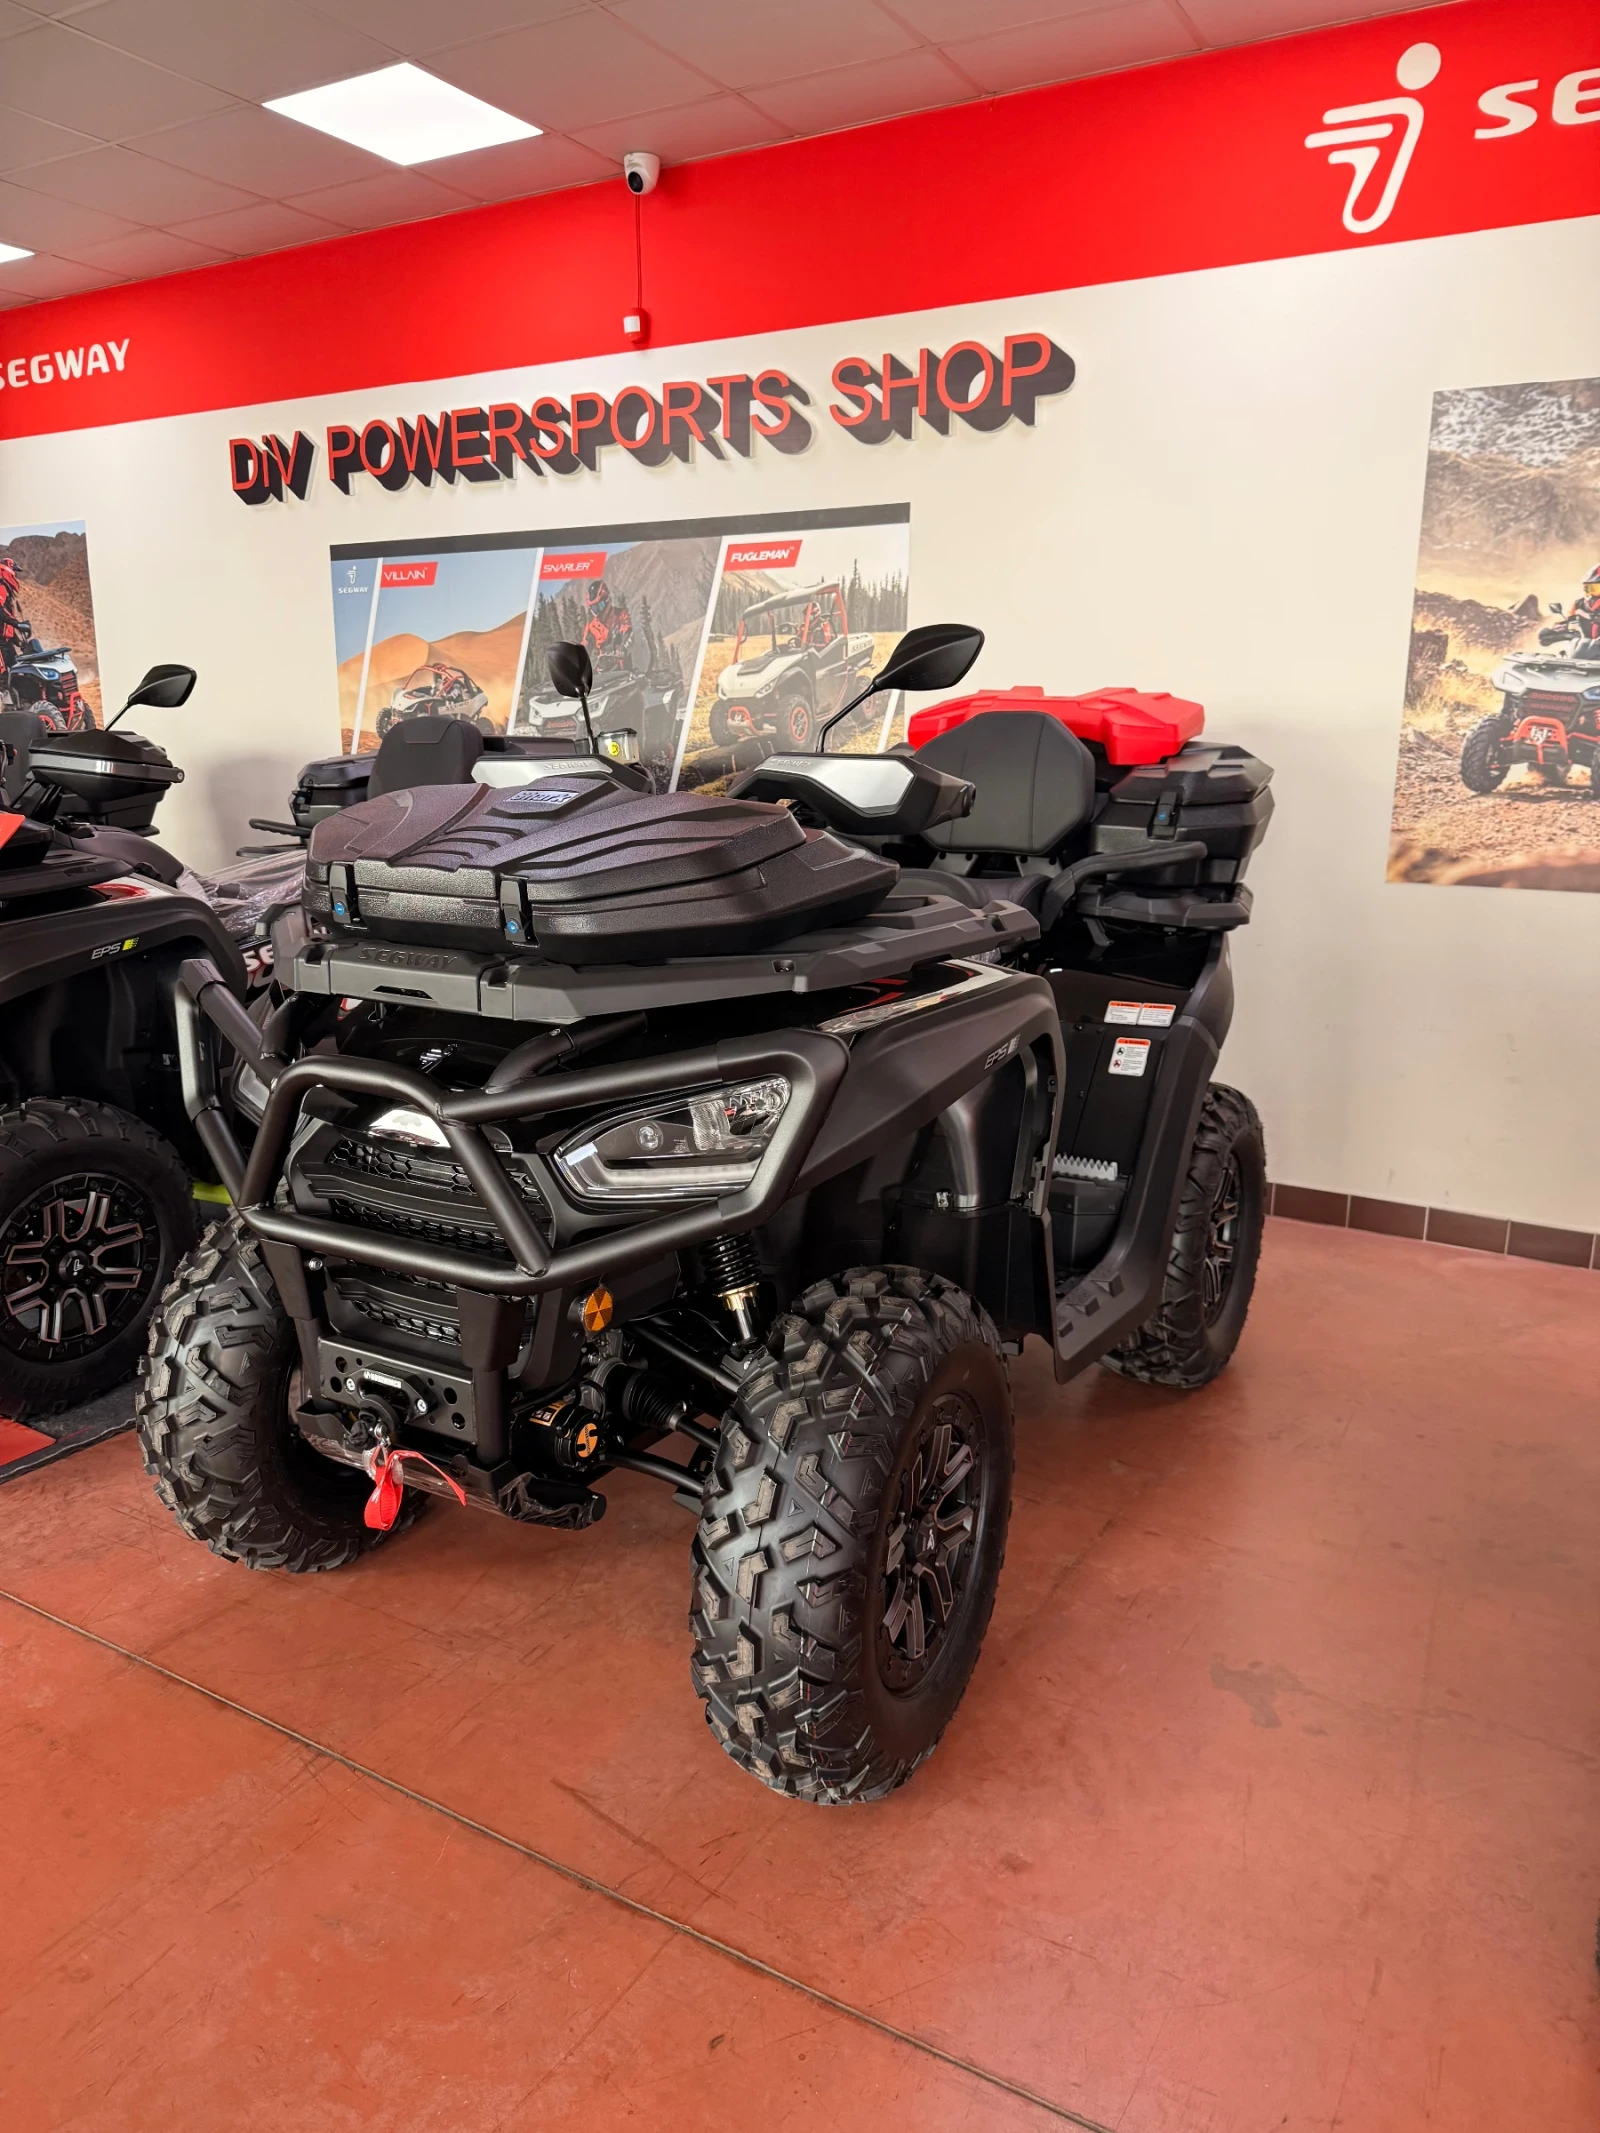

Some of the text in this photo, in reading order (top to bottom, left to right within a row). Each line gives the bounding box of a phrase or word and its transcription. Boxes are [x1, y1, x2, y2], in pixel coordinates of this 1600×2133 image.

[0, 338, 130, 391] EGWAY
[326, 369, 791, 480] POWERSPORTS
[829, 332, 1052, 426] SHOP
[338, 586, 369, 594] SEGWAY
[91, 942, 122, 960] EPS
[358, 947, 458, 970] SEGWAY
[984, 1042, 1009, 1070] EPS
